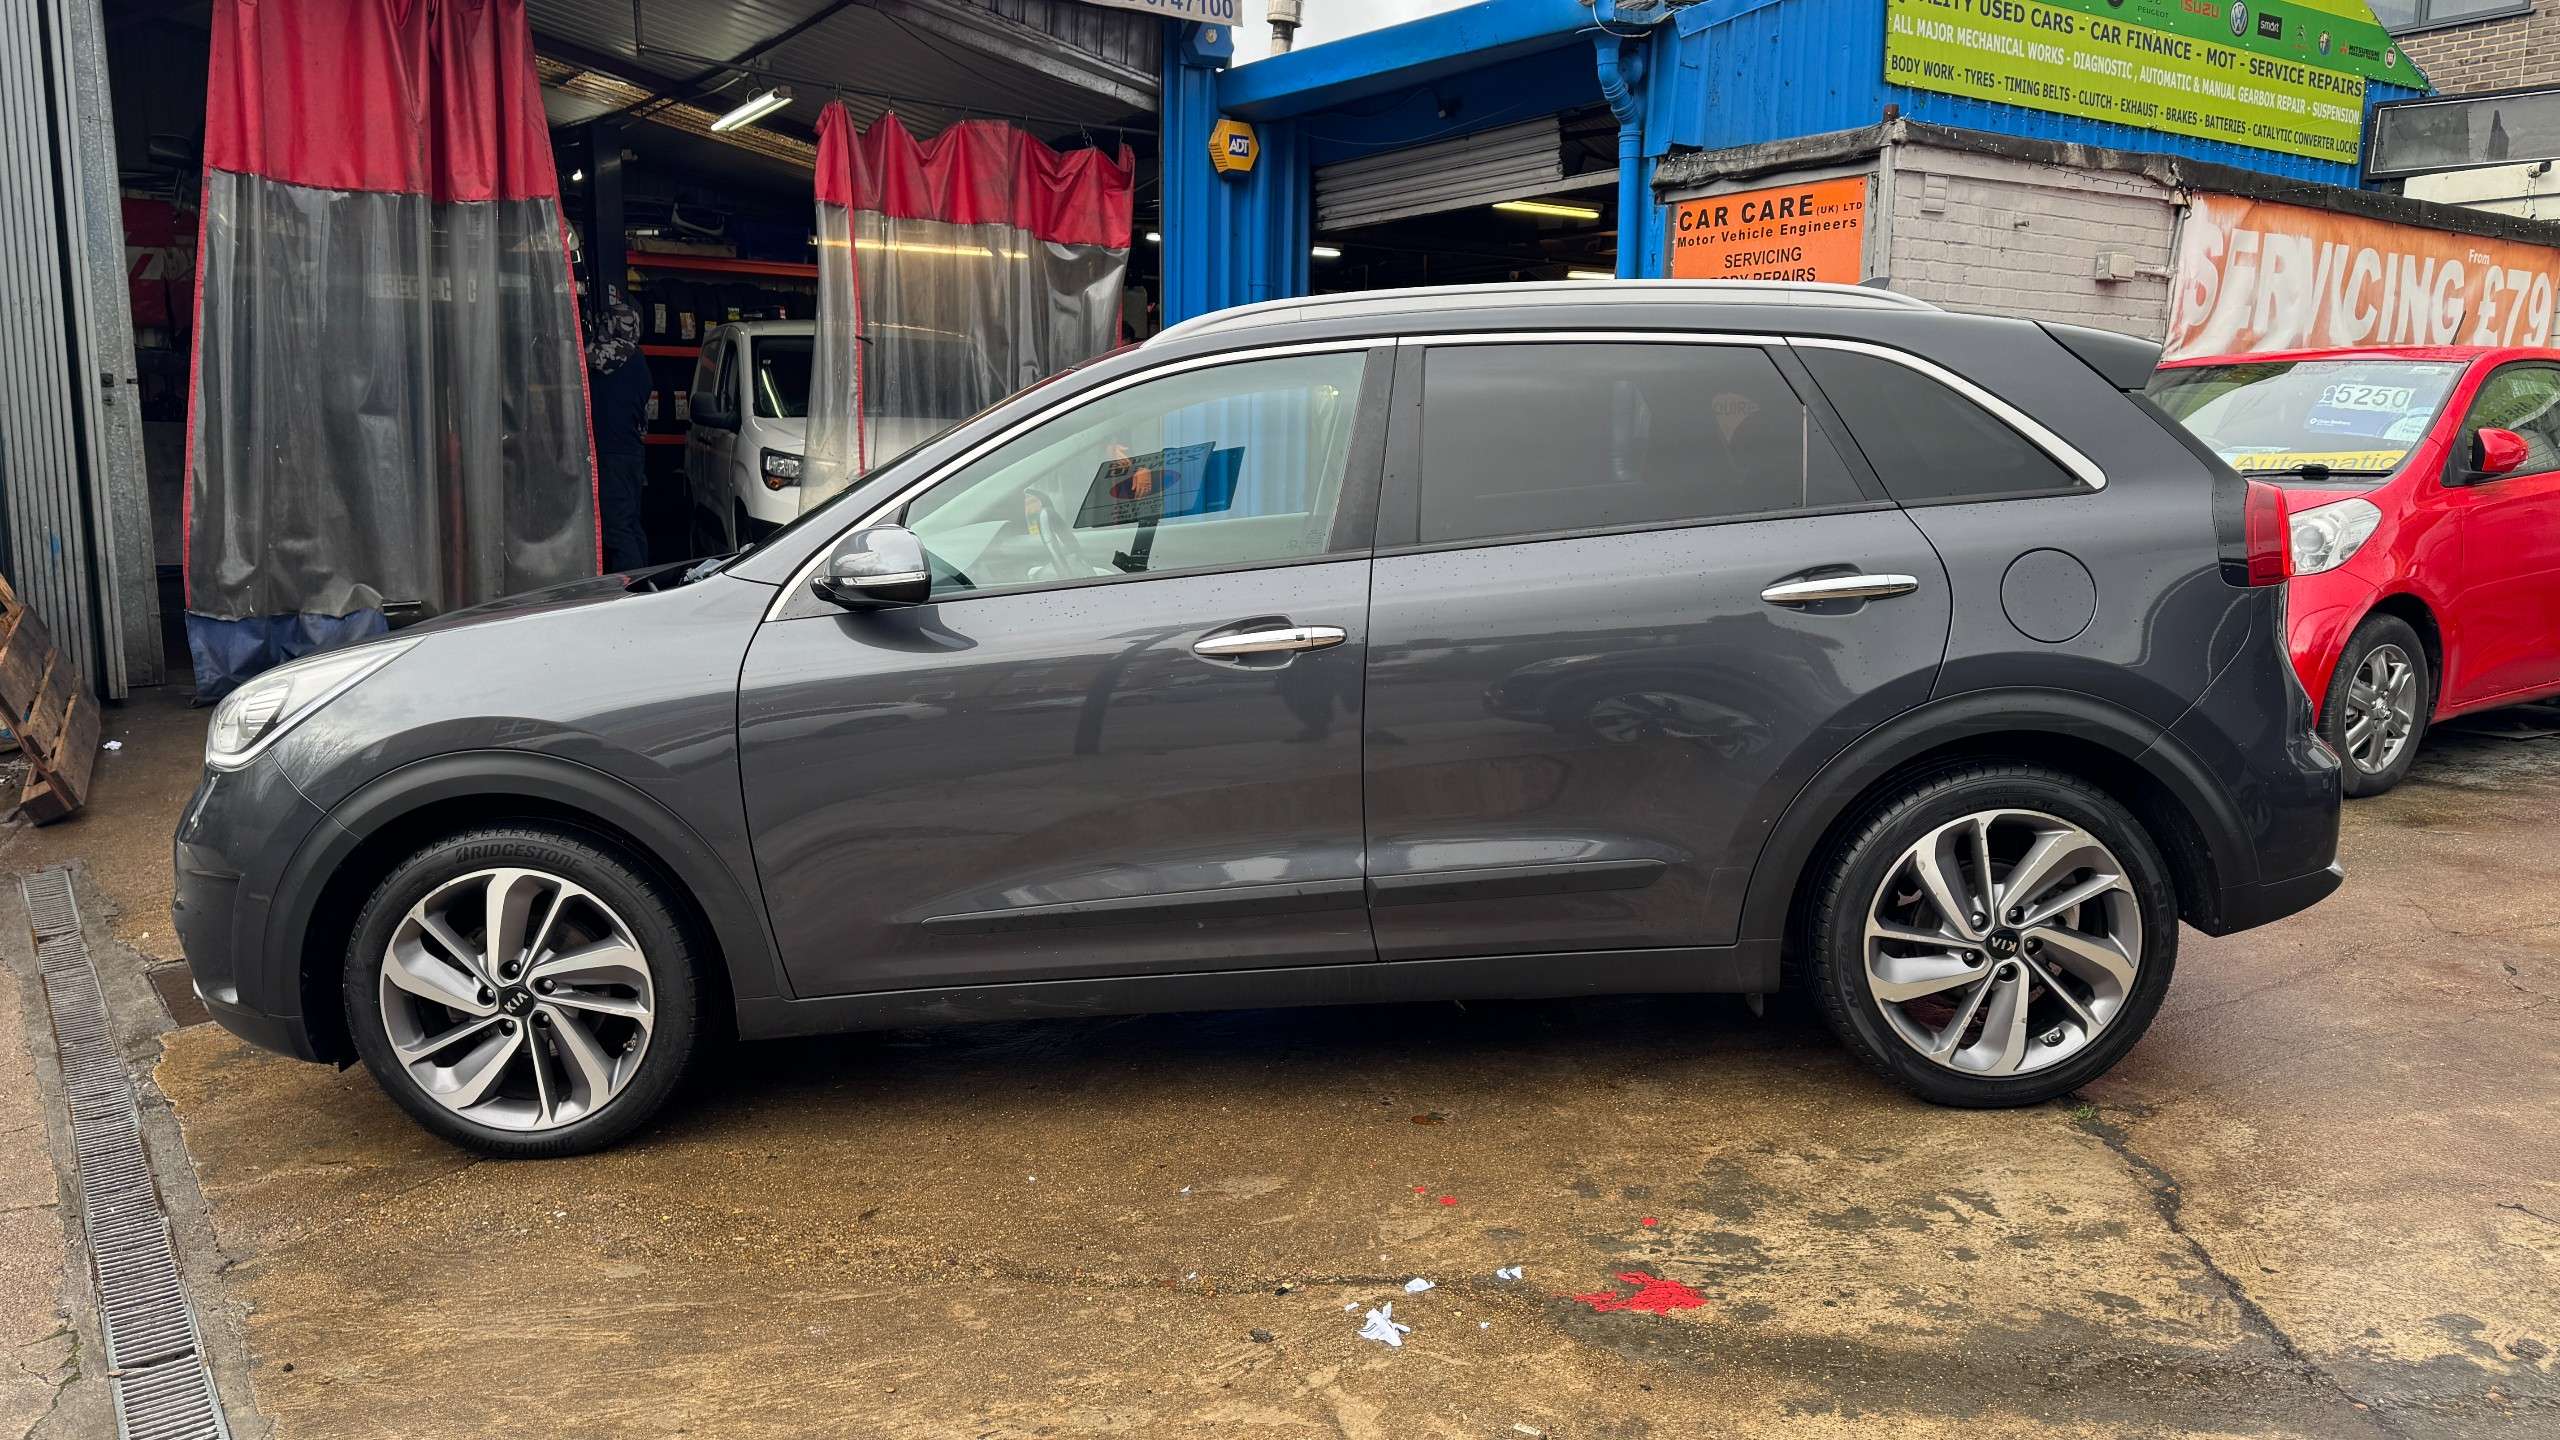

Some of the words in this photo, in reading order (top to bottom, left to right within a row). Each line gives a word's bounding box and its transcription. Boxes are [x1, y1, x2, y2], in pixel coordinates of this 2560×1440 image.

[1980, 0, 2025, 23] USED
[2031, 8, 2074, 34] CARS
[2091, 21, 2121, 45] CAR
[2126, 29, 2192, 60] FINANCE
[2206, 47, 2236, 69] MOT
[2249, 57, 2305, 85] SERVICE
[2308, 70, 2363, 97] REPAIRS
[1893, 13, 1914, 35] ALL
[1916, 18, 1954, 43] MAJOR
[1956, 26, 2025, 58] MECHANICAL
[2027, 41, 2065, 65] WORKS
[2073, 51, 2133, 79] DIAGNOSTIC
[2139, 65, 2192, 91] AUTOMATIC
[2193, 76, 2201, 94] &
[2201, 78, 2237, 100] MANUAL
[2238, 86, 2276, 109] GEARBOX
[2276, 94, 2306, 115] REPAIR
[2312, 101, 2360, 125] SUSPENSION
[1891, 54, 1921, 74] BODY
[1923, 60, 1955, 80] WORK
[1964, 68, 1995, 88] TYRES
[2004, 75, 2040, 97] TIMING
[2042, 83, 2071, 102] BELTS
[2078, 90, 2113, 110] CLUTCH
[2120, 98, 2158, 118] EXHAUST
[2165, 107, 2198, 125] BRAKES
[2205, 114, 2246, 135] BATTERIES
[2252, 123, 2293, 143] CATALYTIC
[2293, 131, 2335, 151] CONVERTER
[2335, 139, 2358, 155] LOCKS
[1229, 138, 1249, 154] ADT
[1679, 206, 1729, 231] CAR
[1741, 194, 1814, 224] CARE
[1816, 204, 1839, 217] (UK)
[1843, 201, 1863, 212] LTD
[1677, 233, 1715, 248] Motor
[1721, 226, 1773, 243] Vehicle
[1780, 217, 1857, 236] Engineers
[1724, 247, 1802, 269] SERVICING
[2468, 248, 2491, 265] From
[2180, 224, 2465, 346] SERVICING
[2474, 265, 2553, 347] £79
[2320, 384, 2410, 408] £5250
[2236, 453, 2398, 470] Automatic
[456, 843, 582, 870] BRIDGESTONE
[1991, 937, 2018, 953] KIA
[504, 991, 529, 1013] KIA
